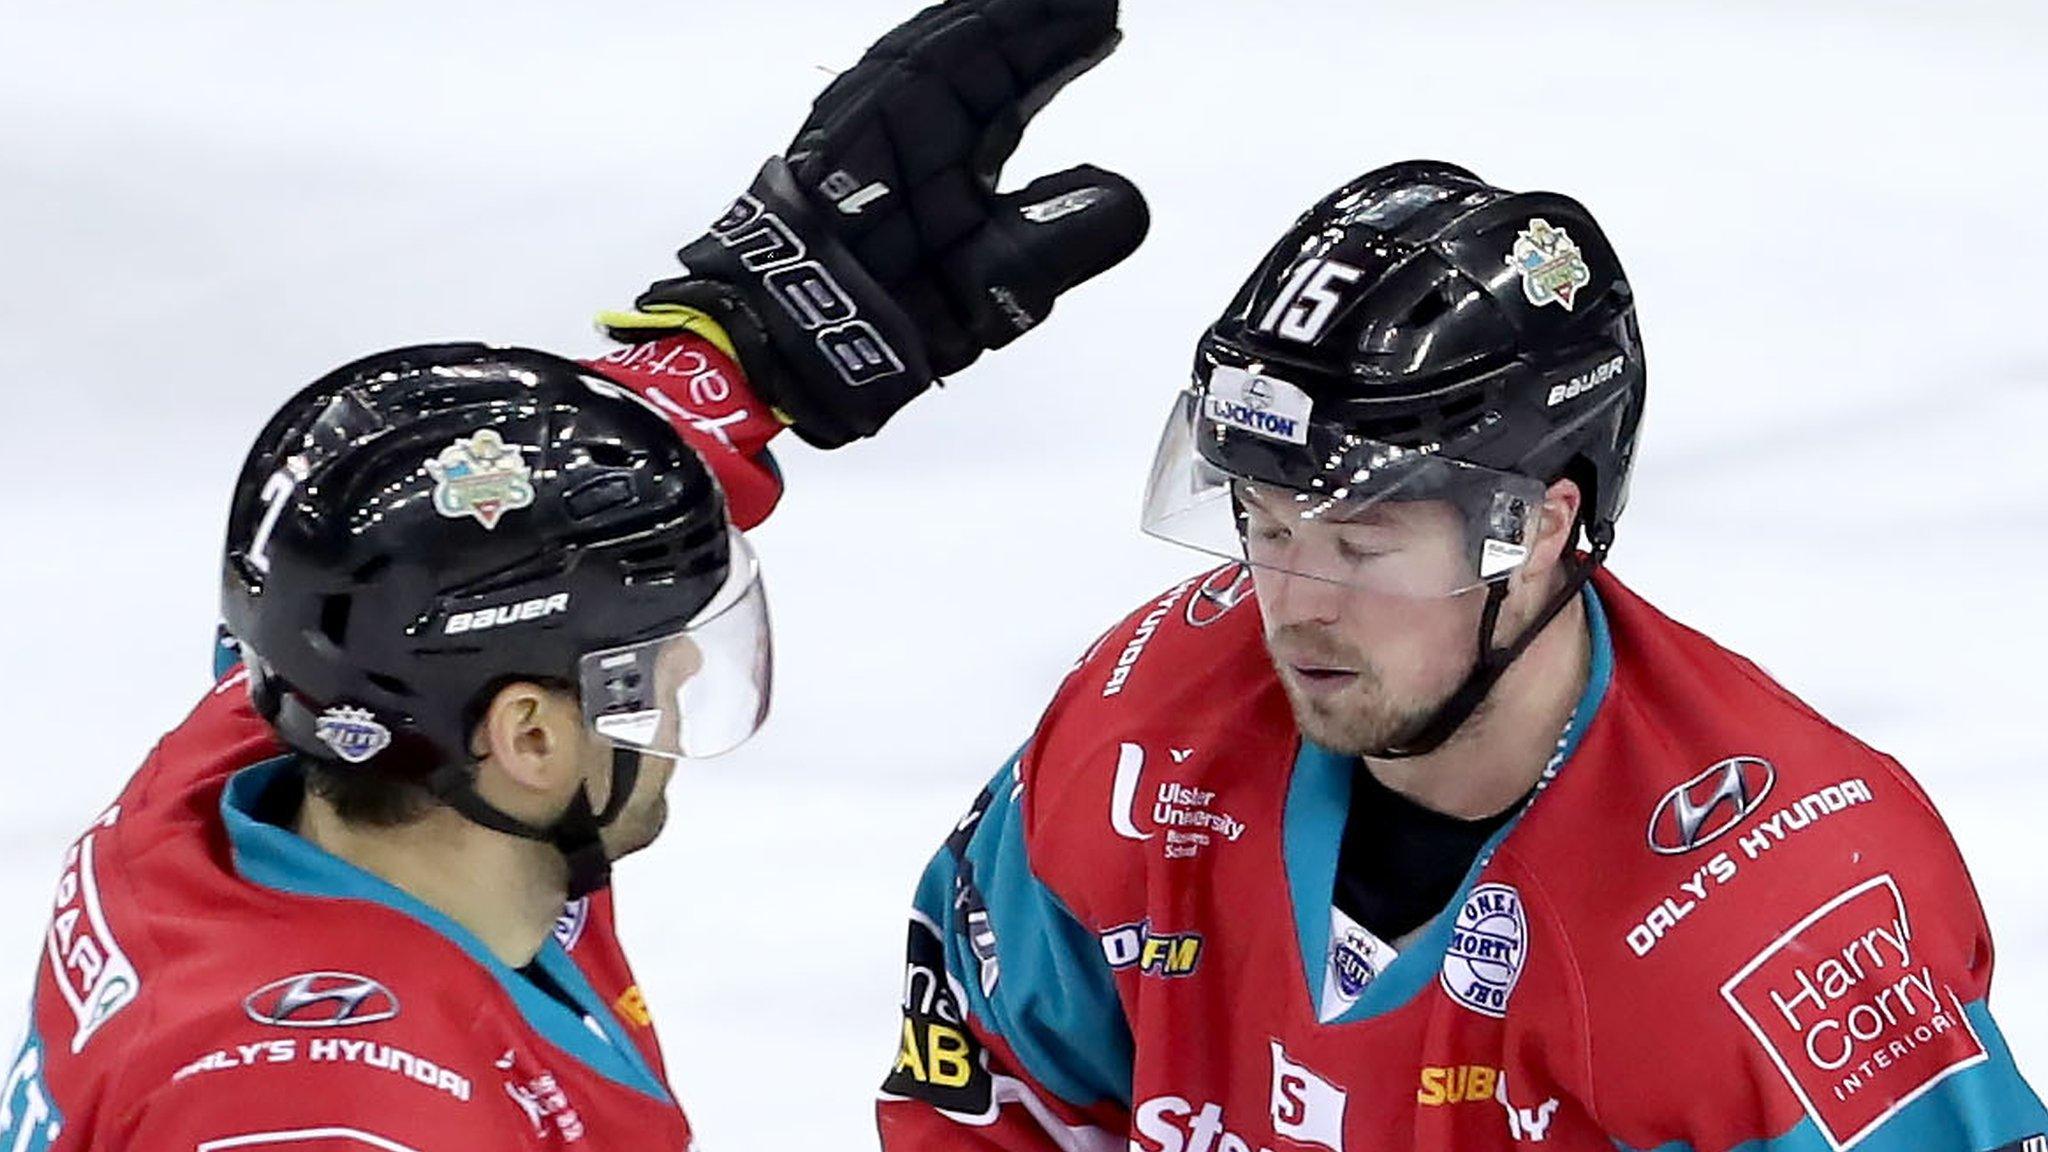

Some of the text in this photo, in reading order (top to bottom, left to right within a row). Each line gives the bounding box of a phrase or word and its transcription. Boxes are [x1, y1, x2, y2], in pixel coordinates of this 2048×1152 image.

[1258, 257, 1367, 343] 15
[443, 592, 570, 635] BAUER
[1626, 778, 1873, 957] DALY'S HYUNDAI
[1769, 917, 1911, 1032] Harry
[1805, 965, 1942, 1071] Corry
[308, 1038, 472, 1102] HYUNDAI
